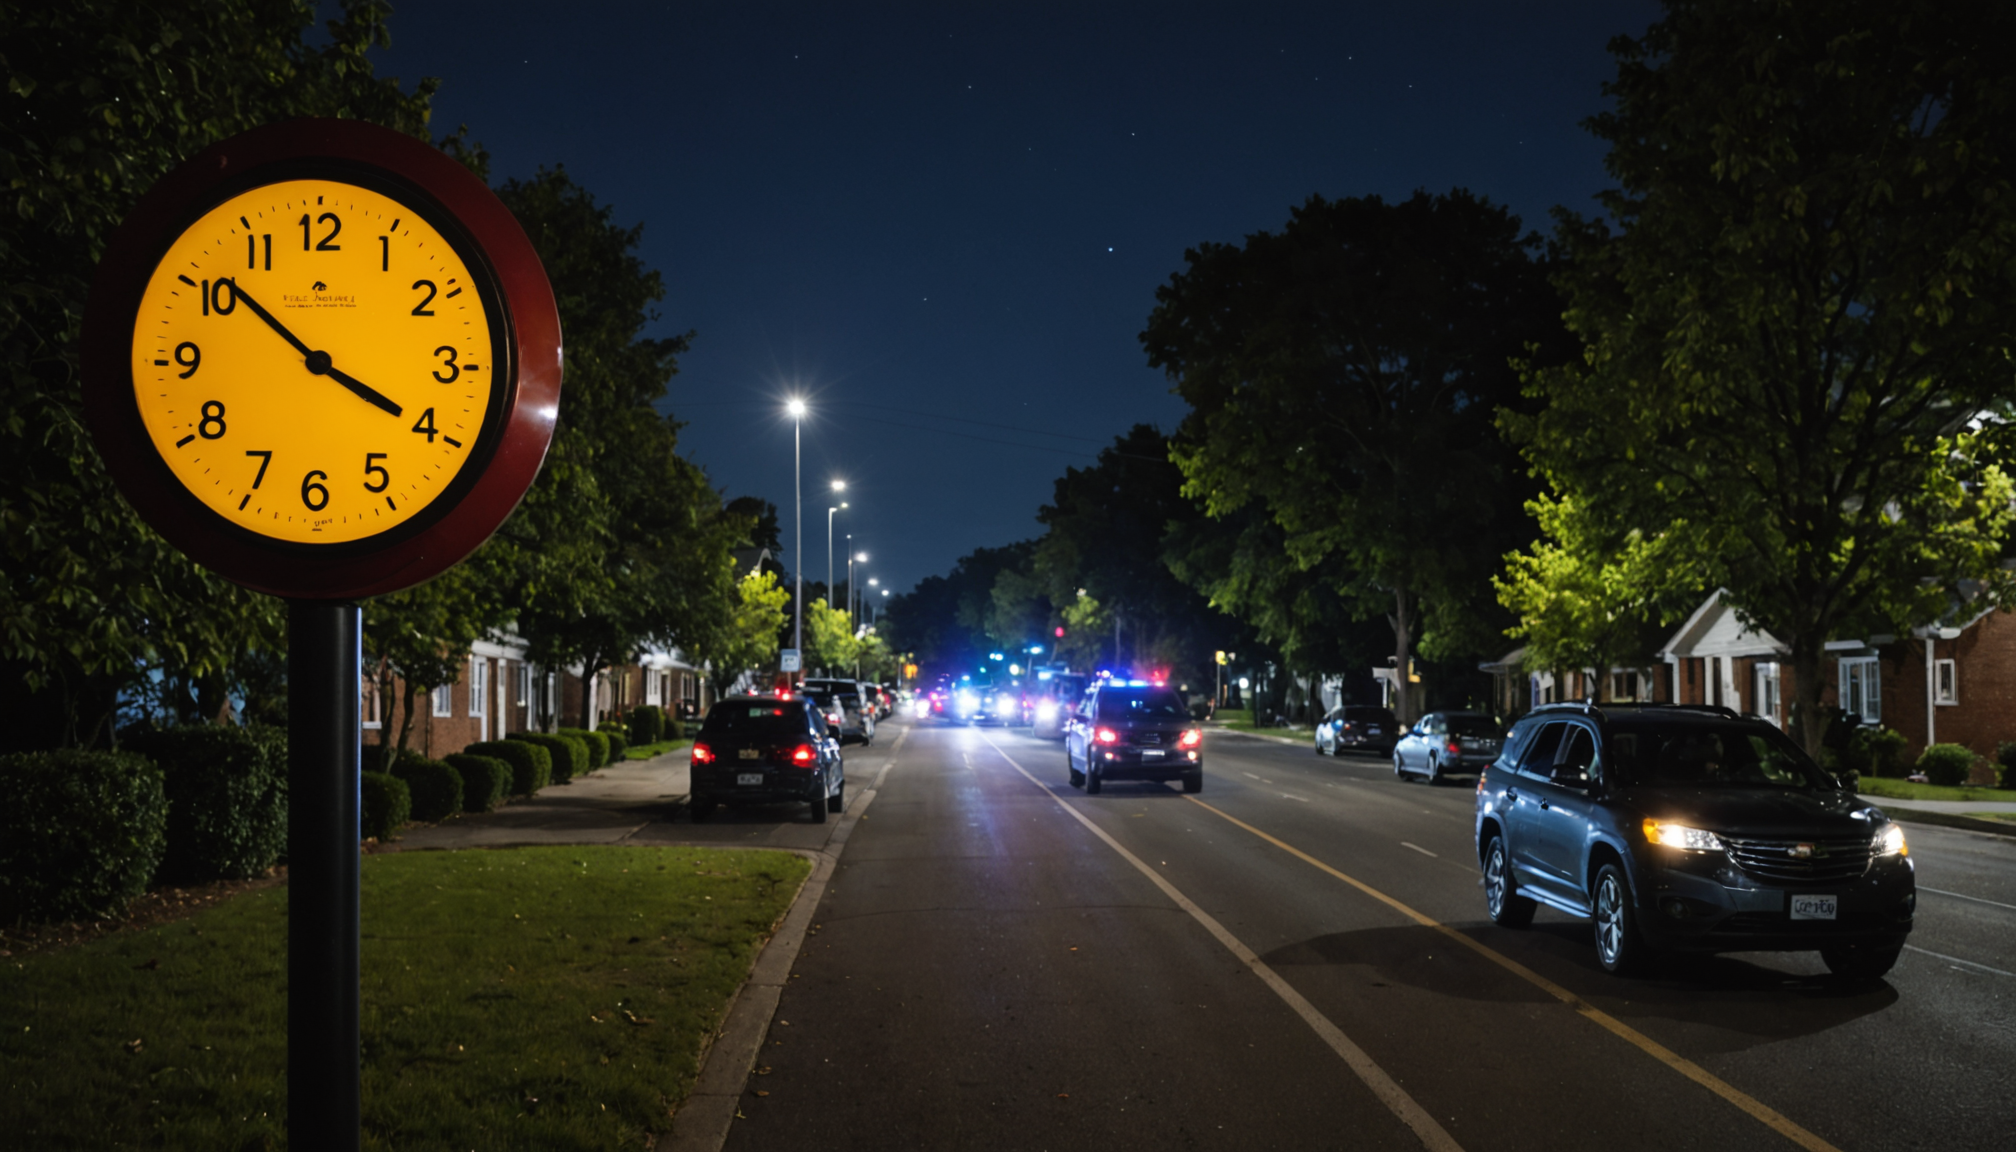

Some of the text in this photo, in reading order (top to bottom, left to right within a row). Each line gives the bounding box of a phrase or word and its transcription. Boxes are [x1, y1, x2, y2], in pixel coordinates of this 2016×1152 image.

[299, 213, 341, 251] 12
[248, 234, 271, 271] 11
[379, 236, 388, 271] 1
[202, 277, 237, 316] 10
[412, 280, 437, 316] 2
[175, 342, 201, 379] 9
[433, 346, 459, 383] 3
[198, 400, 226, 440] 8
[412, 408, 438, 442] 4
[246, 451, 272, 489] 7
[364, 453, 389, 493] 5
[301, 470, 329, 511] 6
